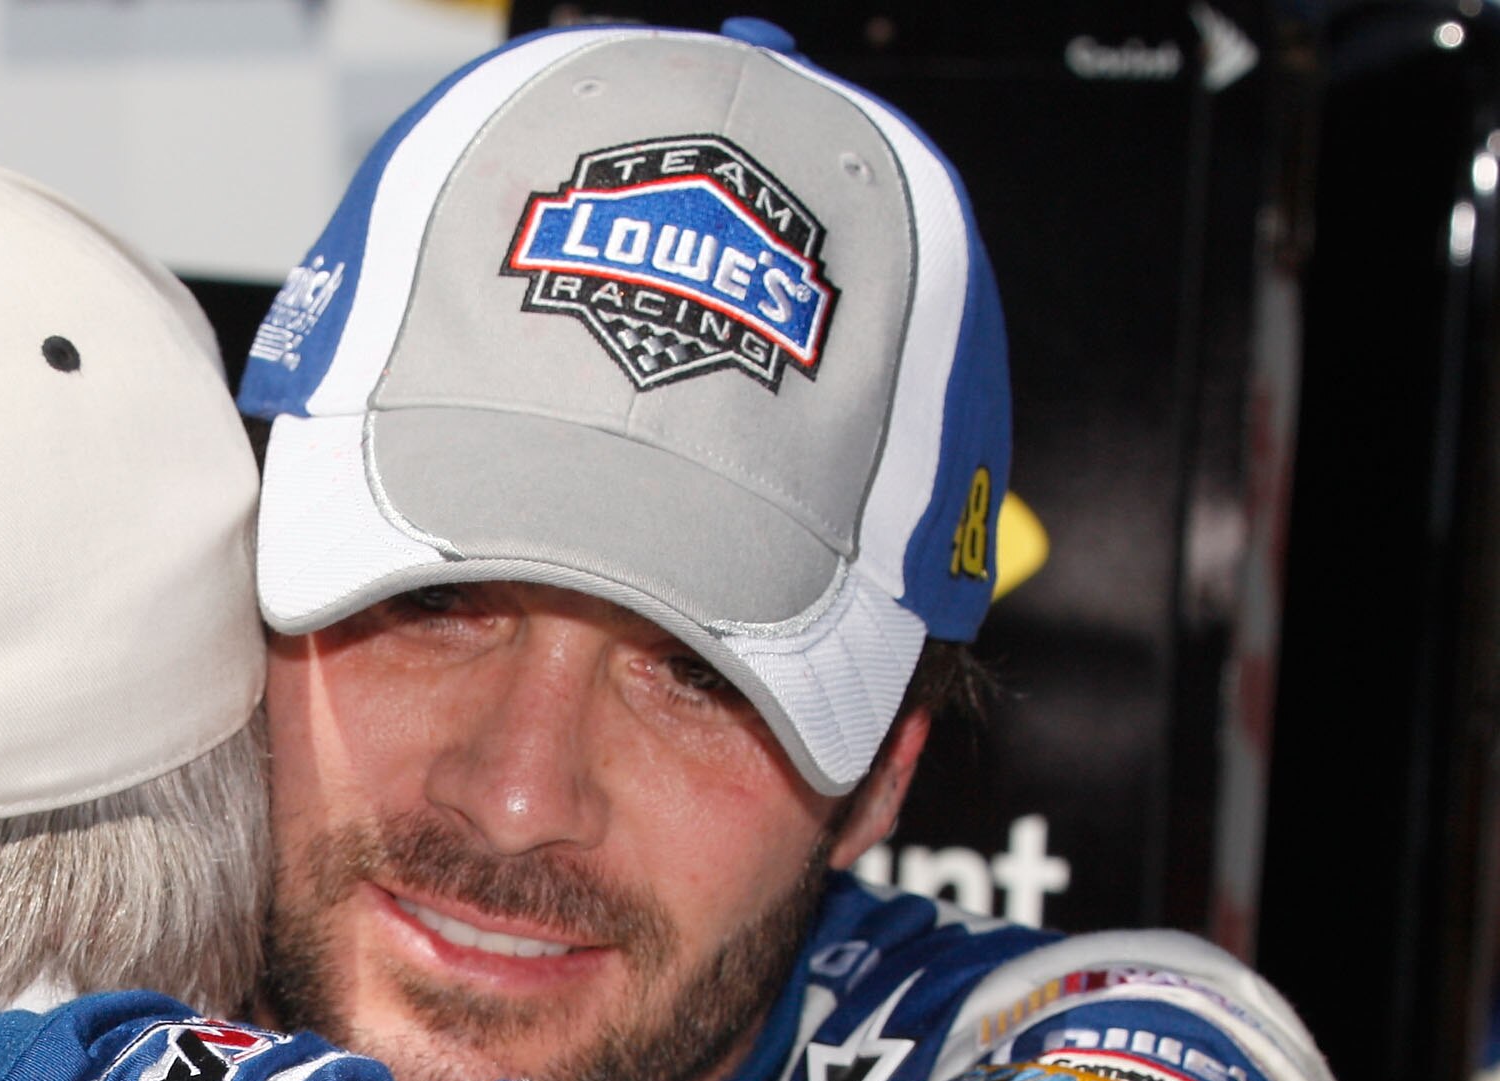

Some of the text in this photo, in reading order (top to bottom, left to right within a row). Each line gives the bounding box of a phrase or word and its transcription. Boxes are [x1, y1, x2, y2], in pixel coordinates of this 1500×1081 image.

[613, 149, 793, 233] TEAM
[561, 203, 798, 324] LOWE'S
[551, 277, 770, 363] RACING
